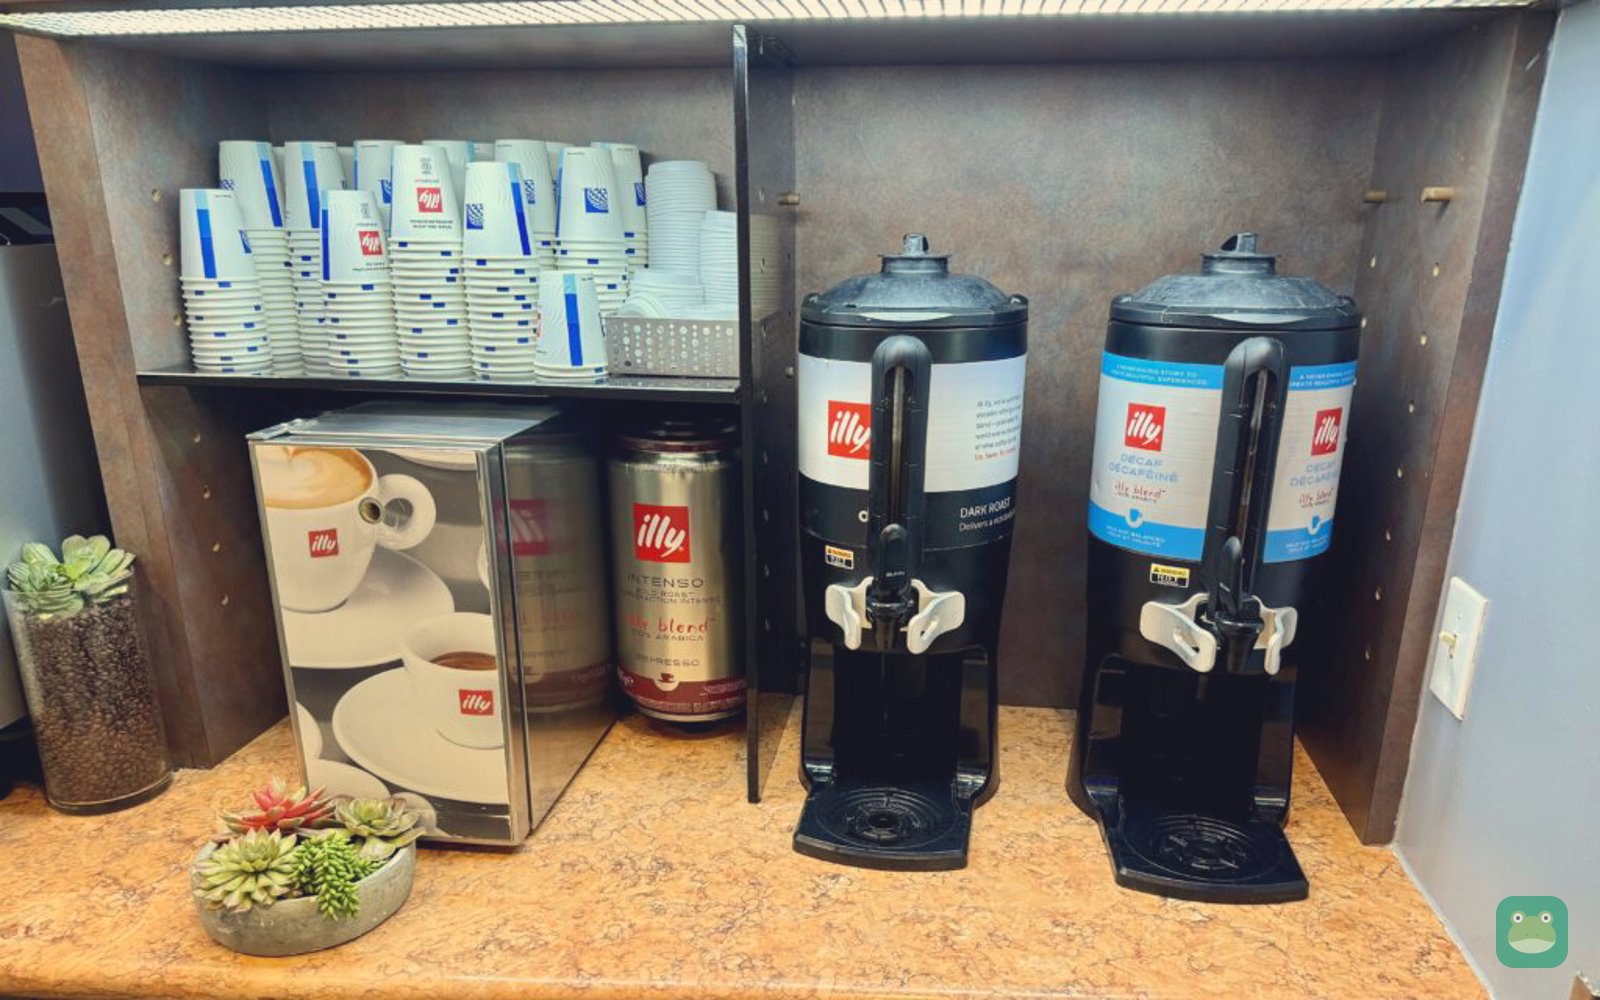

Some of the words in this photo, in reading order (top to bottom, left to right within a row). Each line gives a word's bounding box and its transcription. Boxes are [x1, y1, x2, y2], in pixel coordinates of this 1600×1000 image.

[418, 190, 441, 209] illy
[830, 410, 871, 454] illy
[1127, 411, 1162, 446] illy
[1314, 415, 1339, 450] illy
[1120, 453, 1163, 467] DECAF
[960, 505, 988, 518] DARK
[988, 496, 1011, 514] ROAST
[958, 518, 988, 532] Delivers
[311, 535, 336, 552] illy
[637, 513, 686, 558] illy
[627, 573, 704, 588] INTENSO
[462, 693, 494, 713] illy
